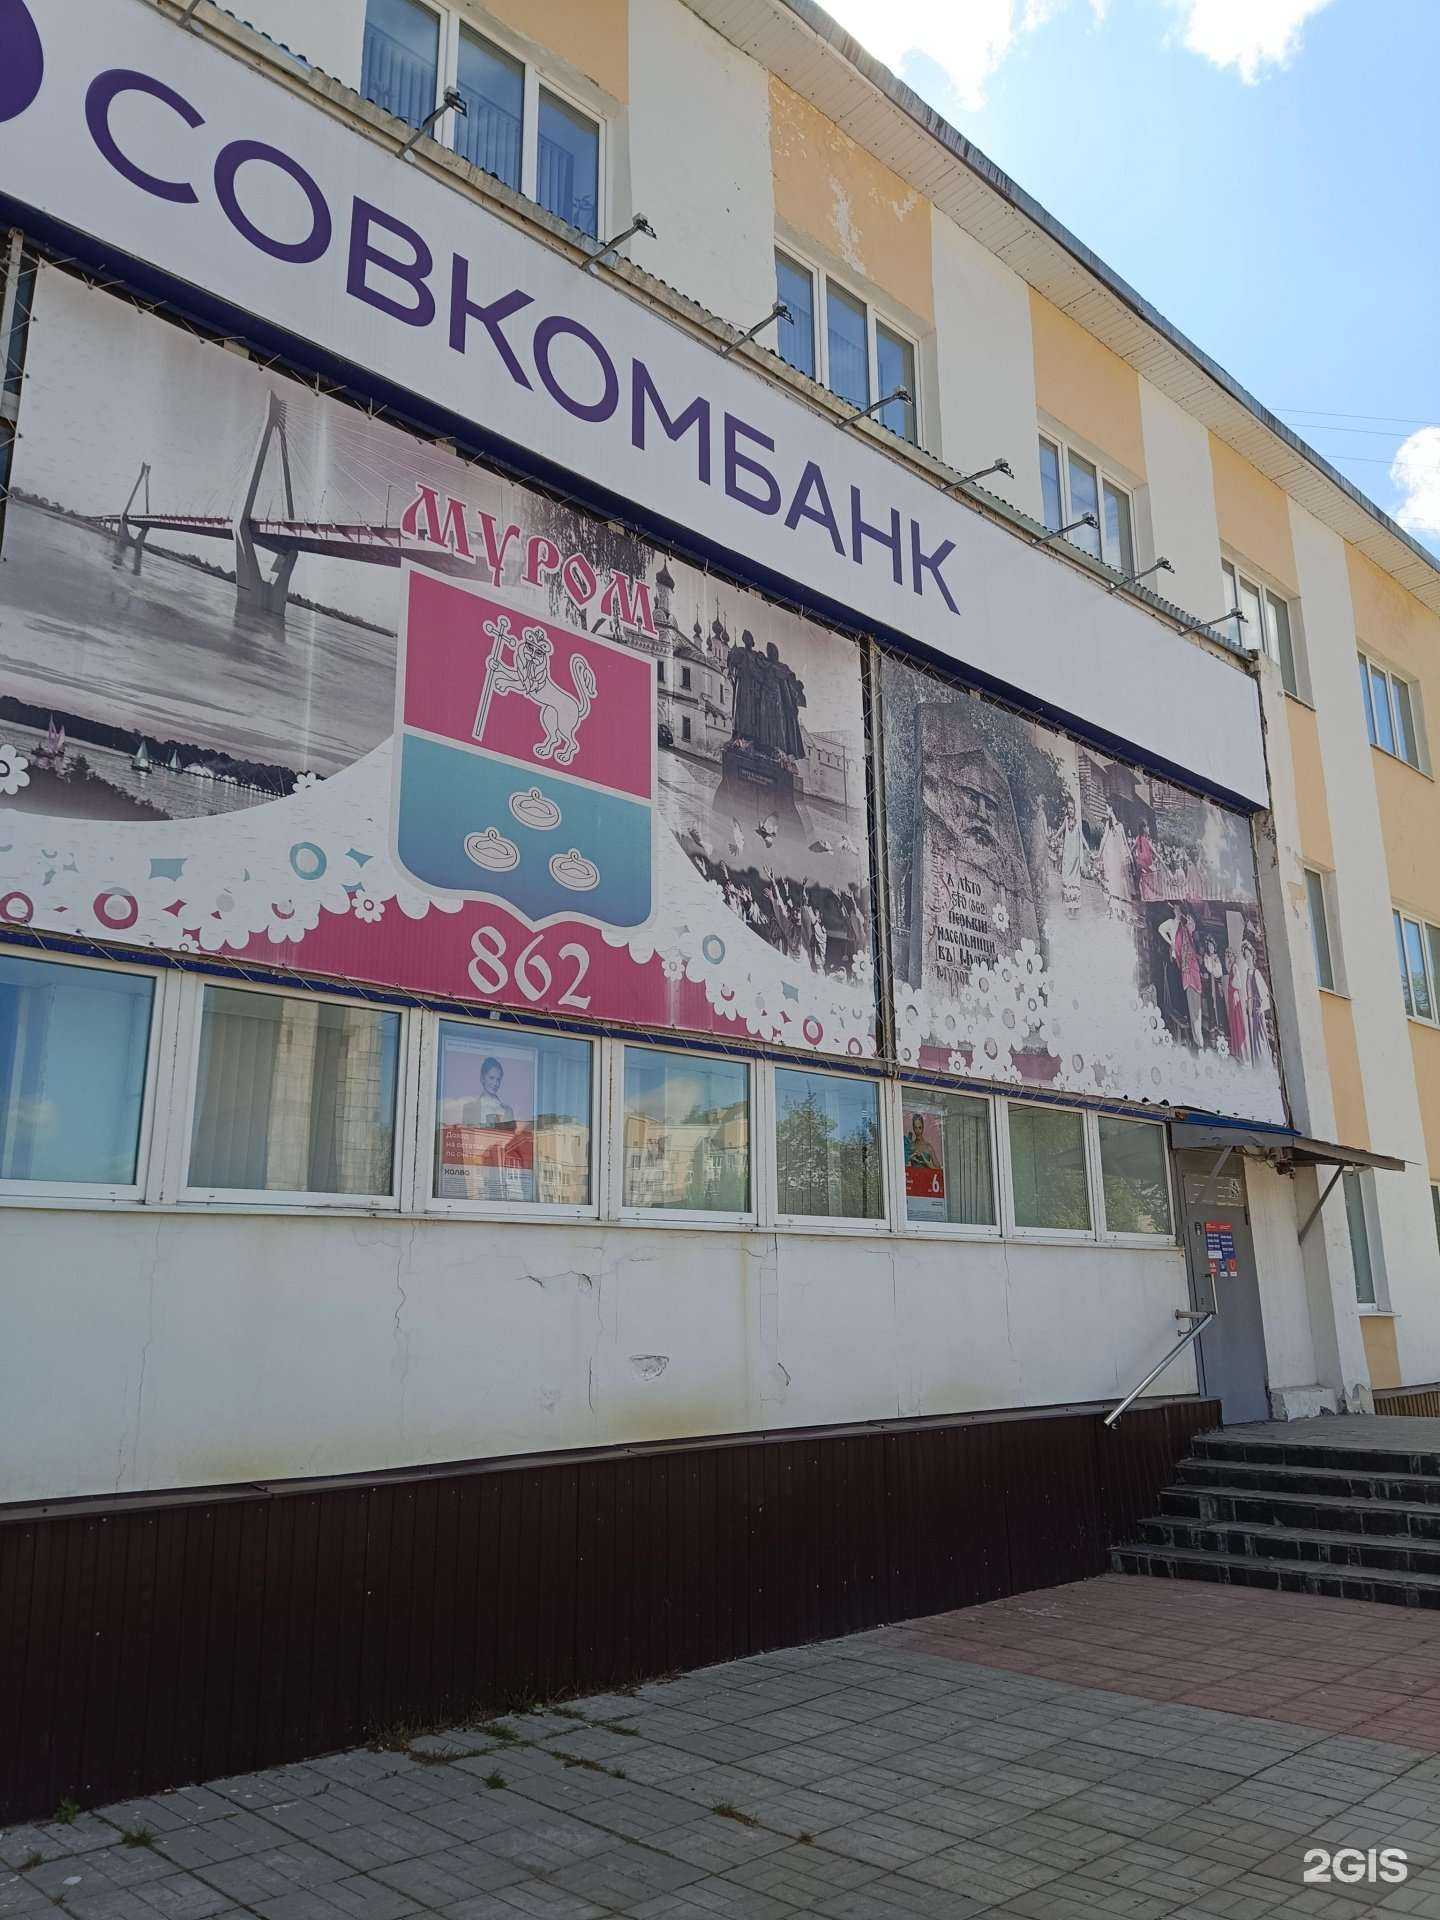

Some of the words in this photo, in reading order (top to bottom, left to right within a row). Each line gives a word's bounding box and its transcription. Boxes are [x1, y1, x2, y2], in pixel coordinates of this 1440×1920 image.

[85, 69, 961, 615] СОВКОМБАНК
[400, 484, 660, 637] МУРОМ
[468, 926, 592, 1009] 862
[932, 1174, 940, 1193] 6
